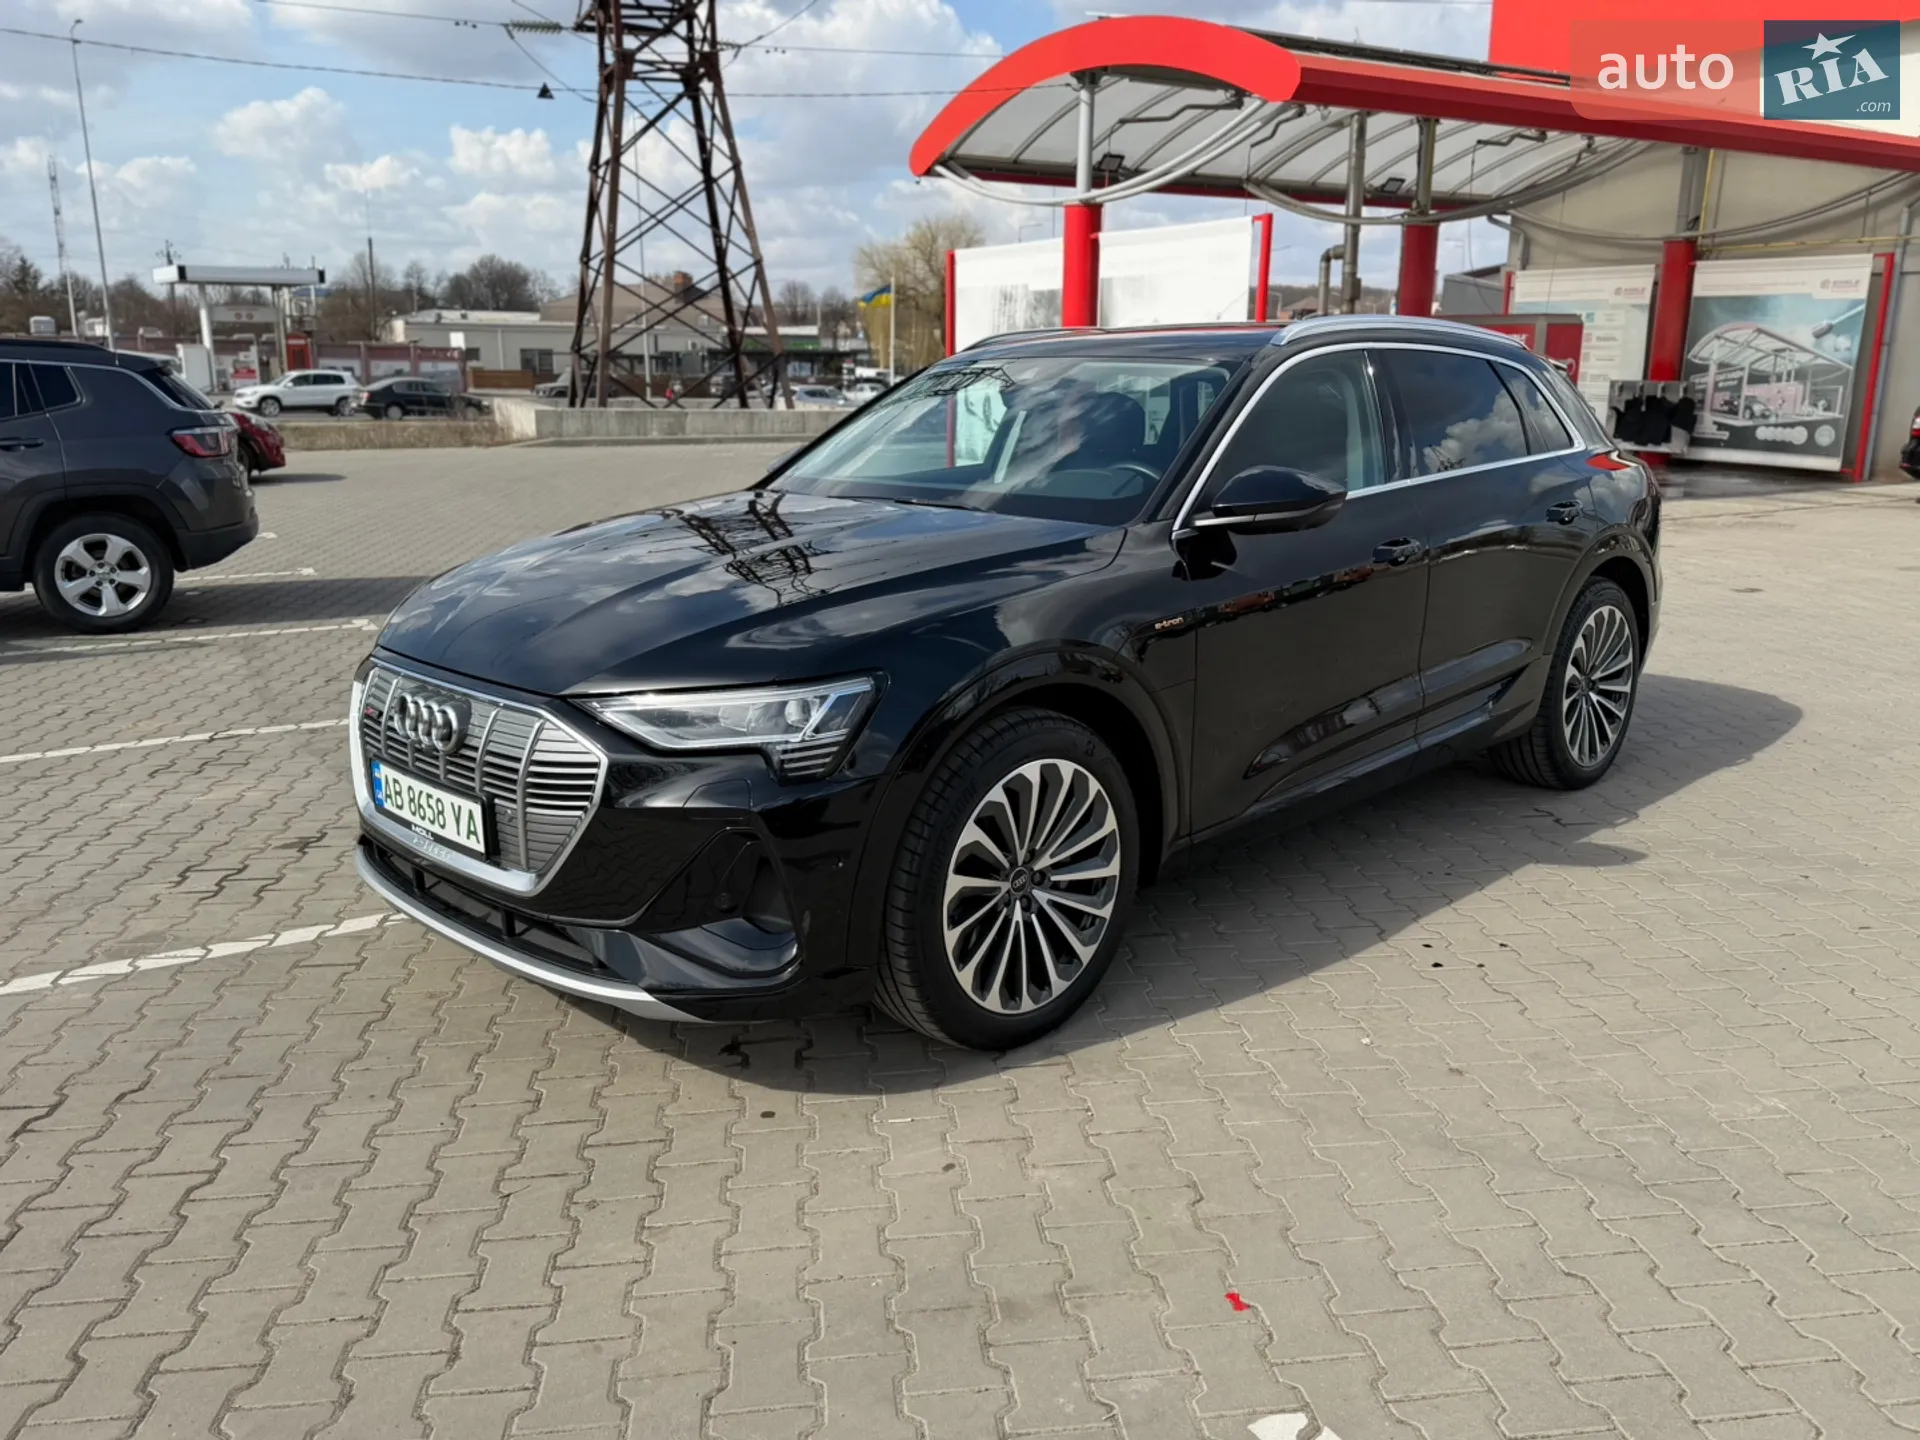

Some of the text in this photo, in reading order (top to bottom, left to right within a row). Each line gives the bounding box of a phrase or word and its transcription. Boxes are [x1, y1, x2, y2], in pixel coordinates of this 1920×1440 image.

[384, 774, 481, 844] AB 8658 YA
